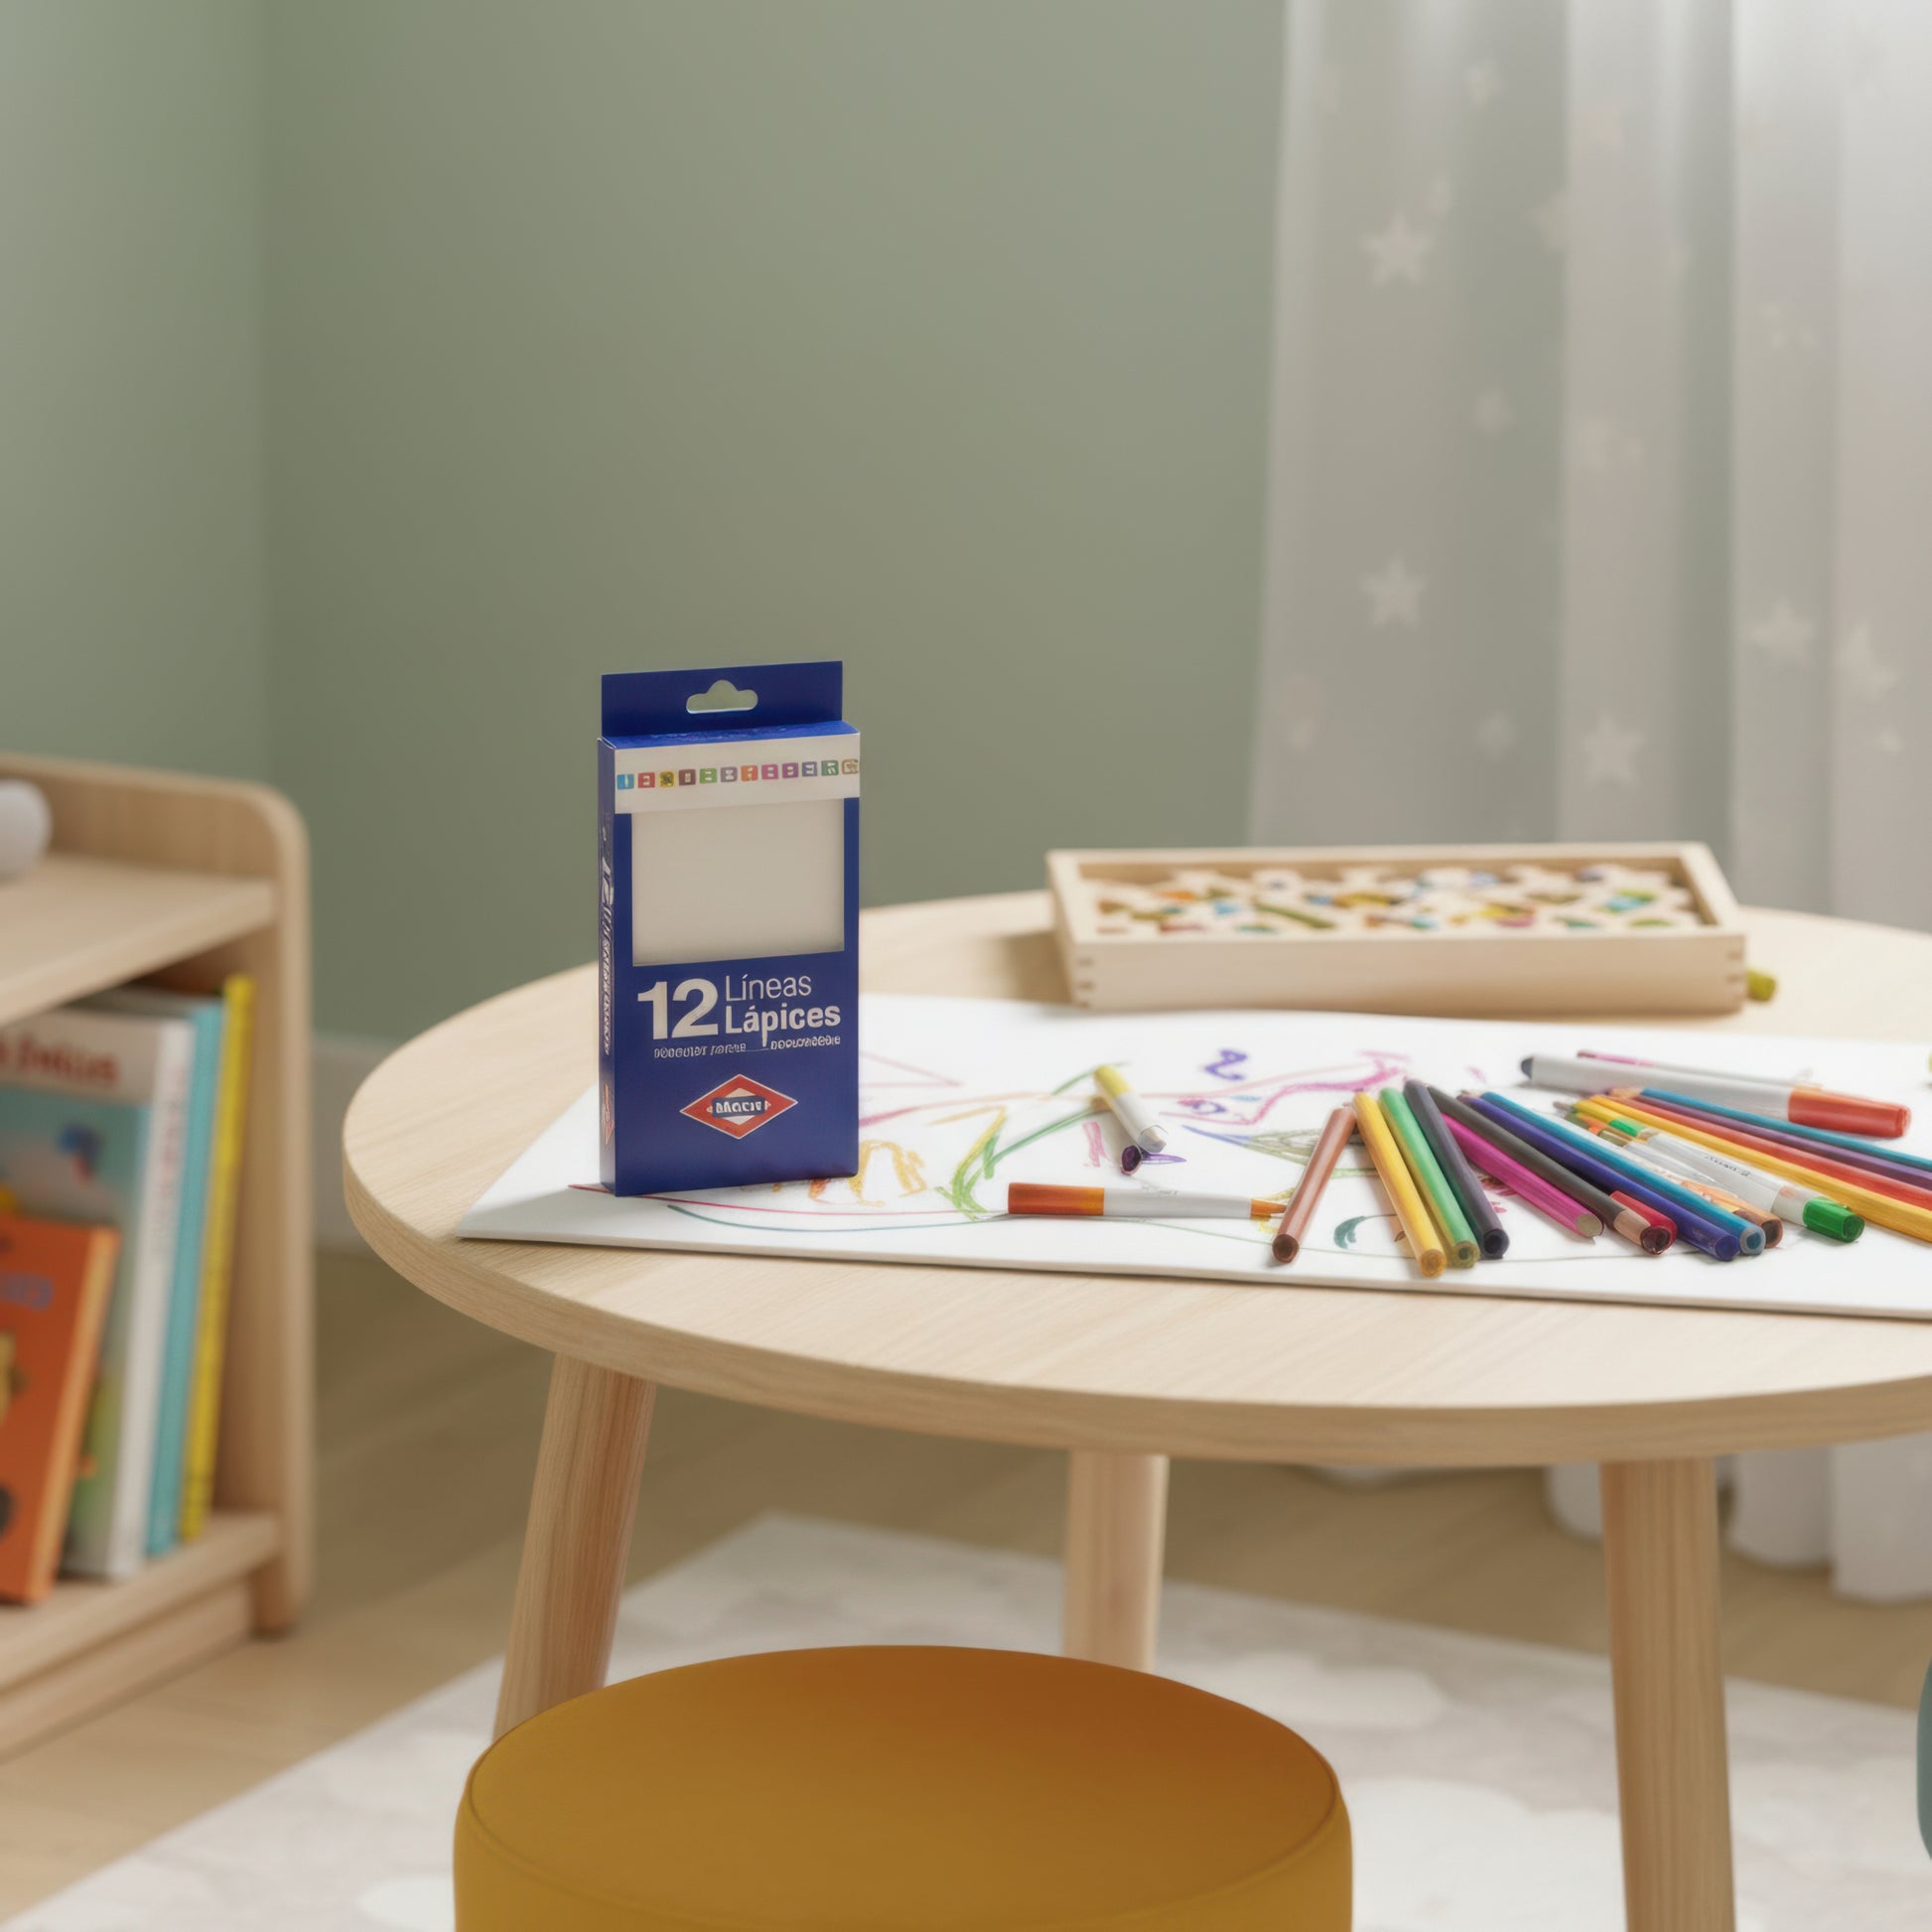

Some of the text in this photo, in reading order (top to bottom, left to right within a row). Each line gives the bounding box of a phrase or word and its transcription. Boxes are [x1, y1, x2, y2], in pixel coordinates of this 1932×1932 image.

[637, 974, 812, 1039] 12 Líneas
[725, 1003, 841, 1046] Lápices
